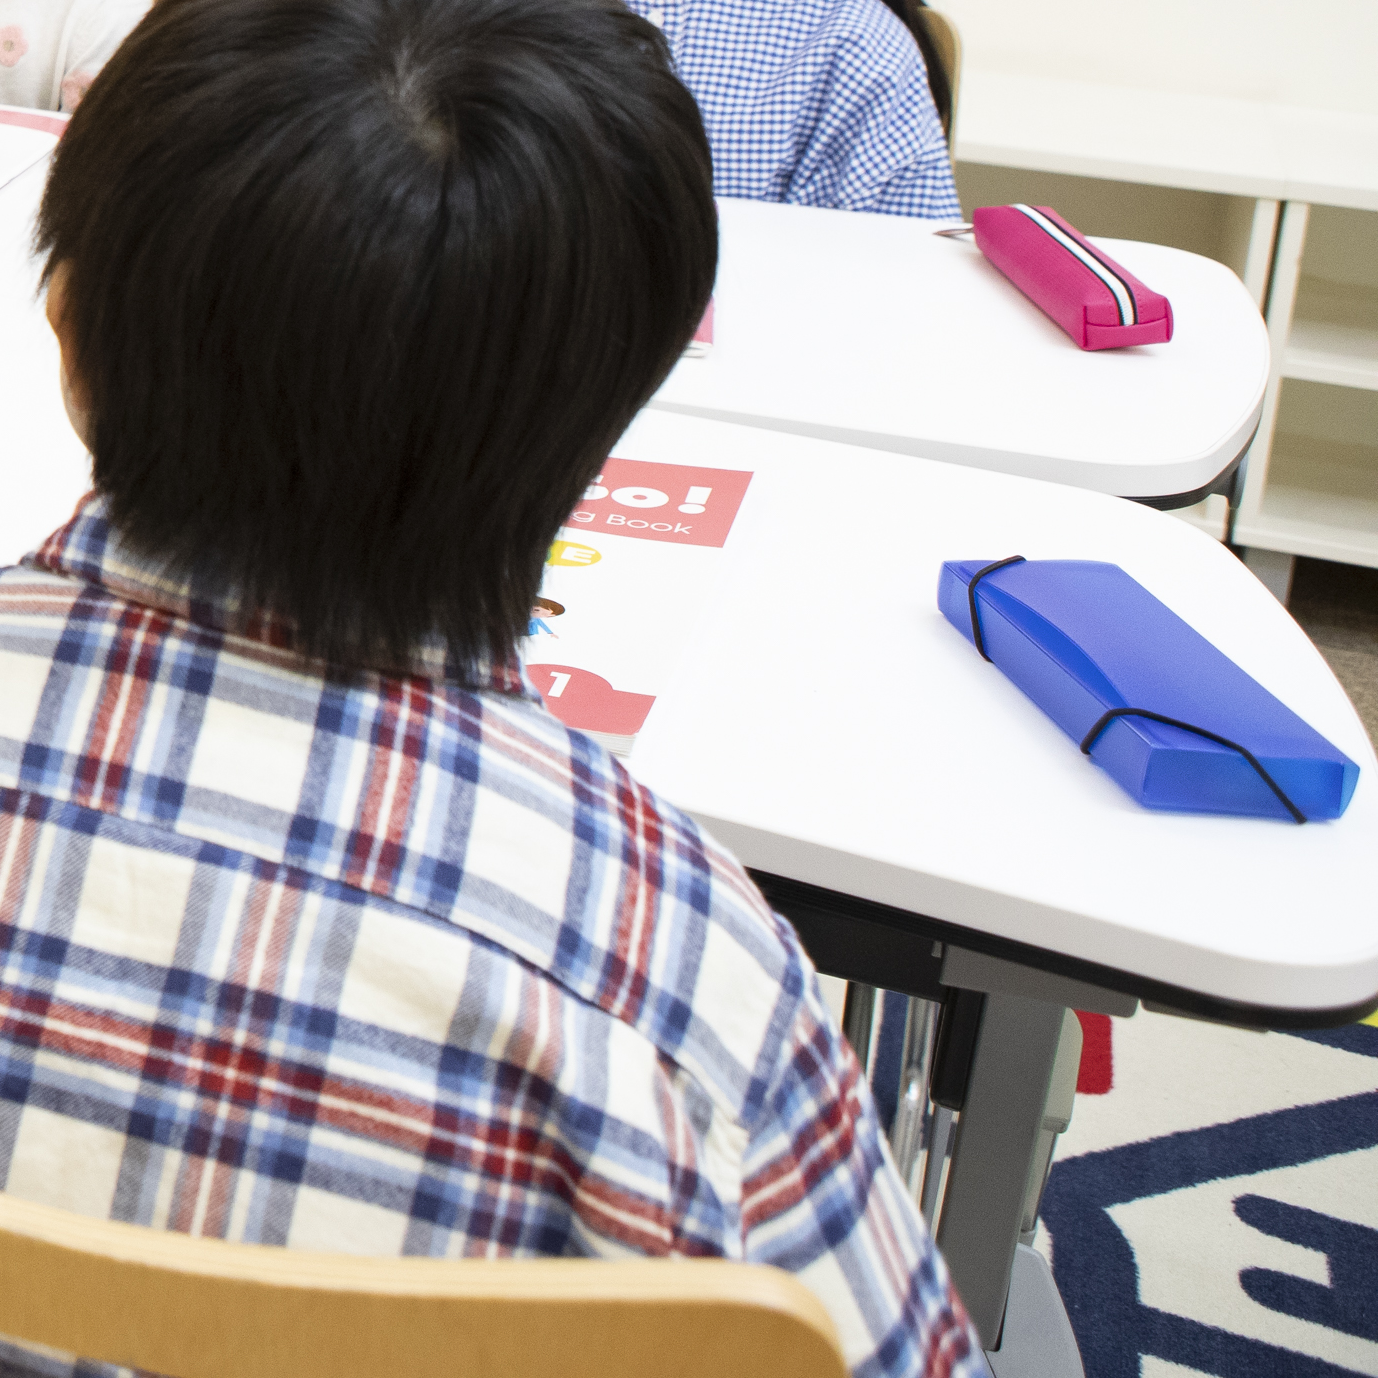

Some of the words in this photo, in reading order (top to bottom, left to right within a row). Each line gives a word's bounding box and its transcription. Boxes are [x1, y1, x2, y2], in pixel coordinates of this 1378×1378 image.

[606, 513, 693, 535] Book
[560, 545, 596, 564] E
[547, 671, 572, 698] 1
